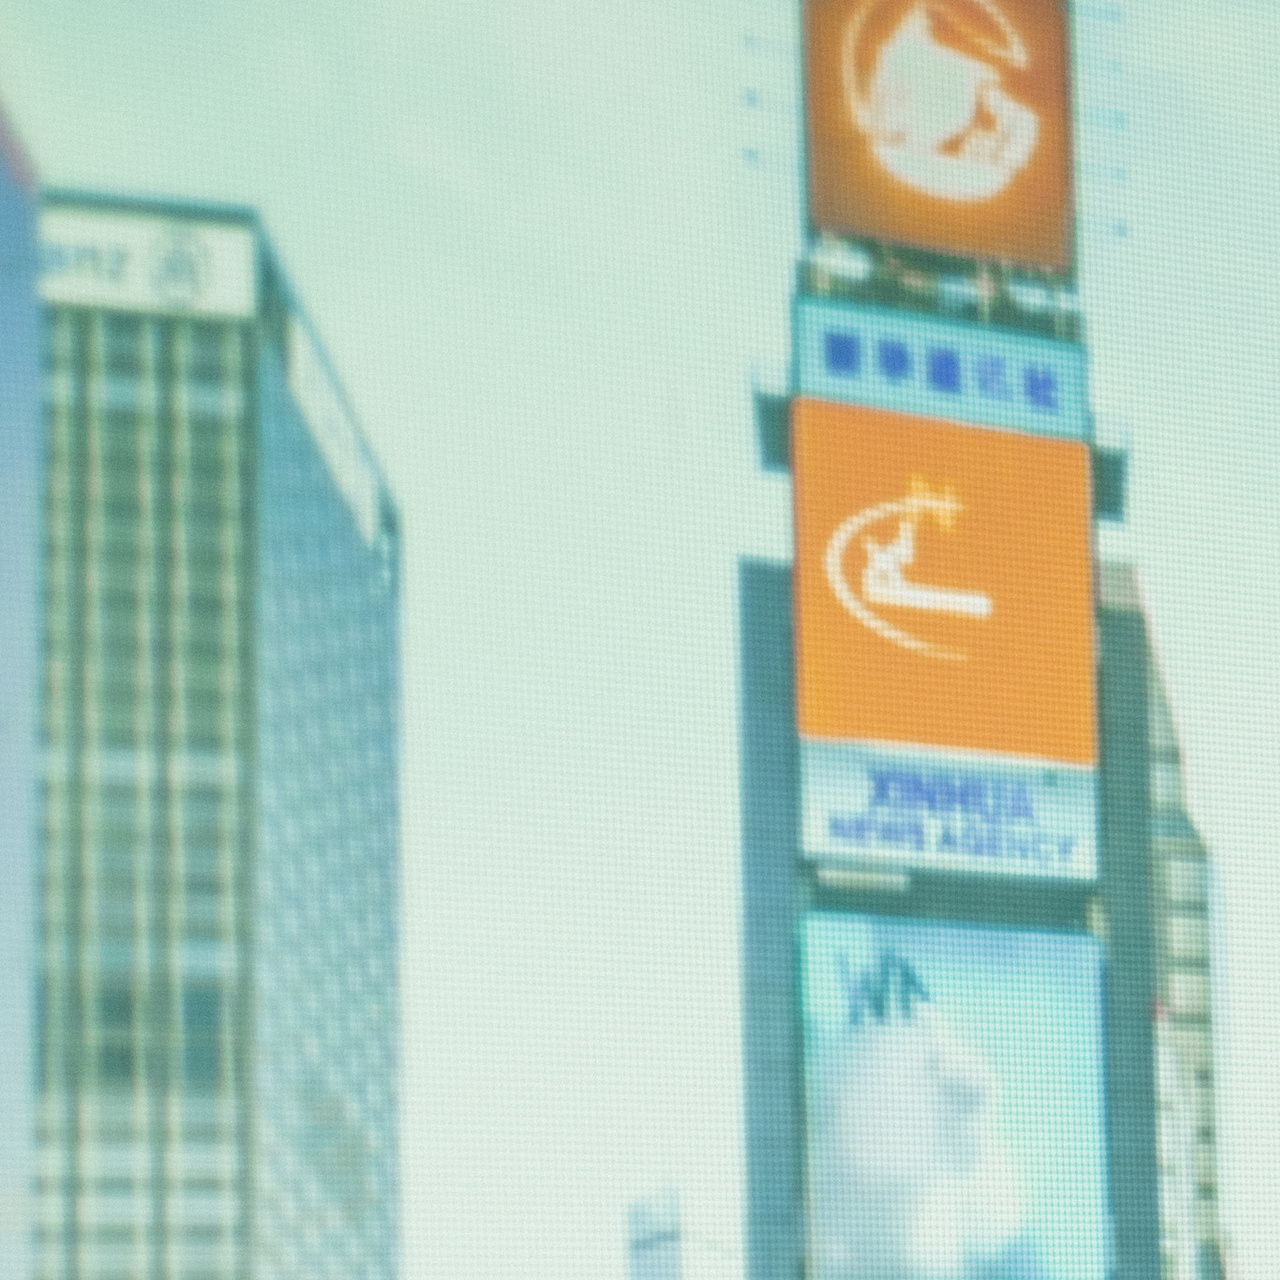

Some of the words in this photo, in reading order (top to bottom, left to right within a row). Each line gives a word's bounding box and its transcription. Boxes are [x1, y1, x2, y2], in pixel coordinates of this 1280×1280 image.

[870, 769, 1034, 821] XINHUA
[829, 816, 925, 851] NEWS
[940, 821, 1074, 863] AGENCY
